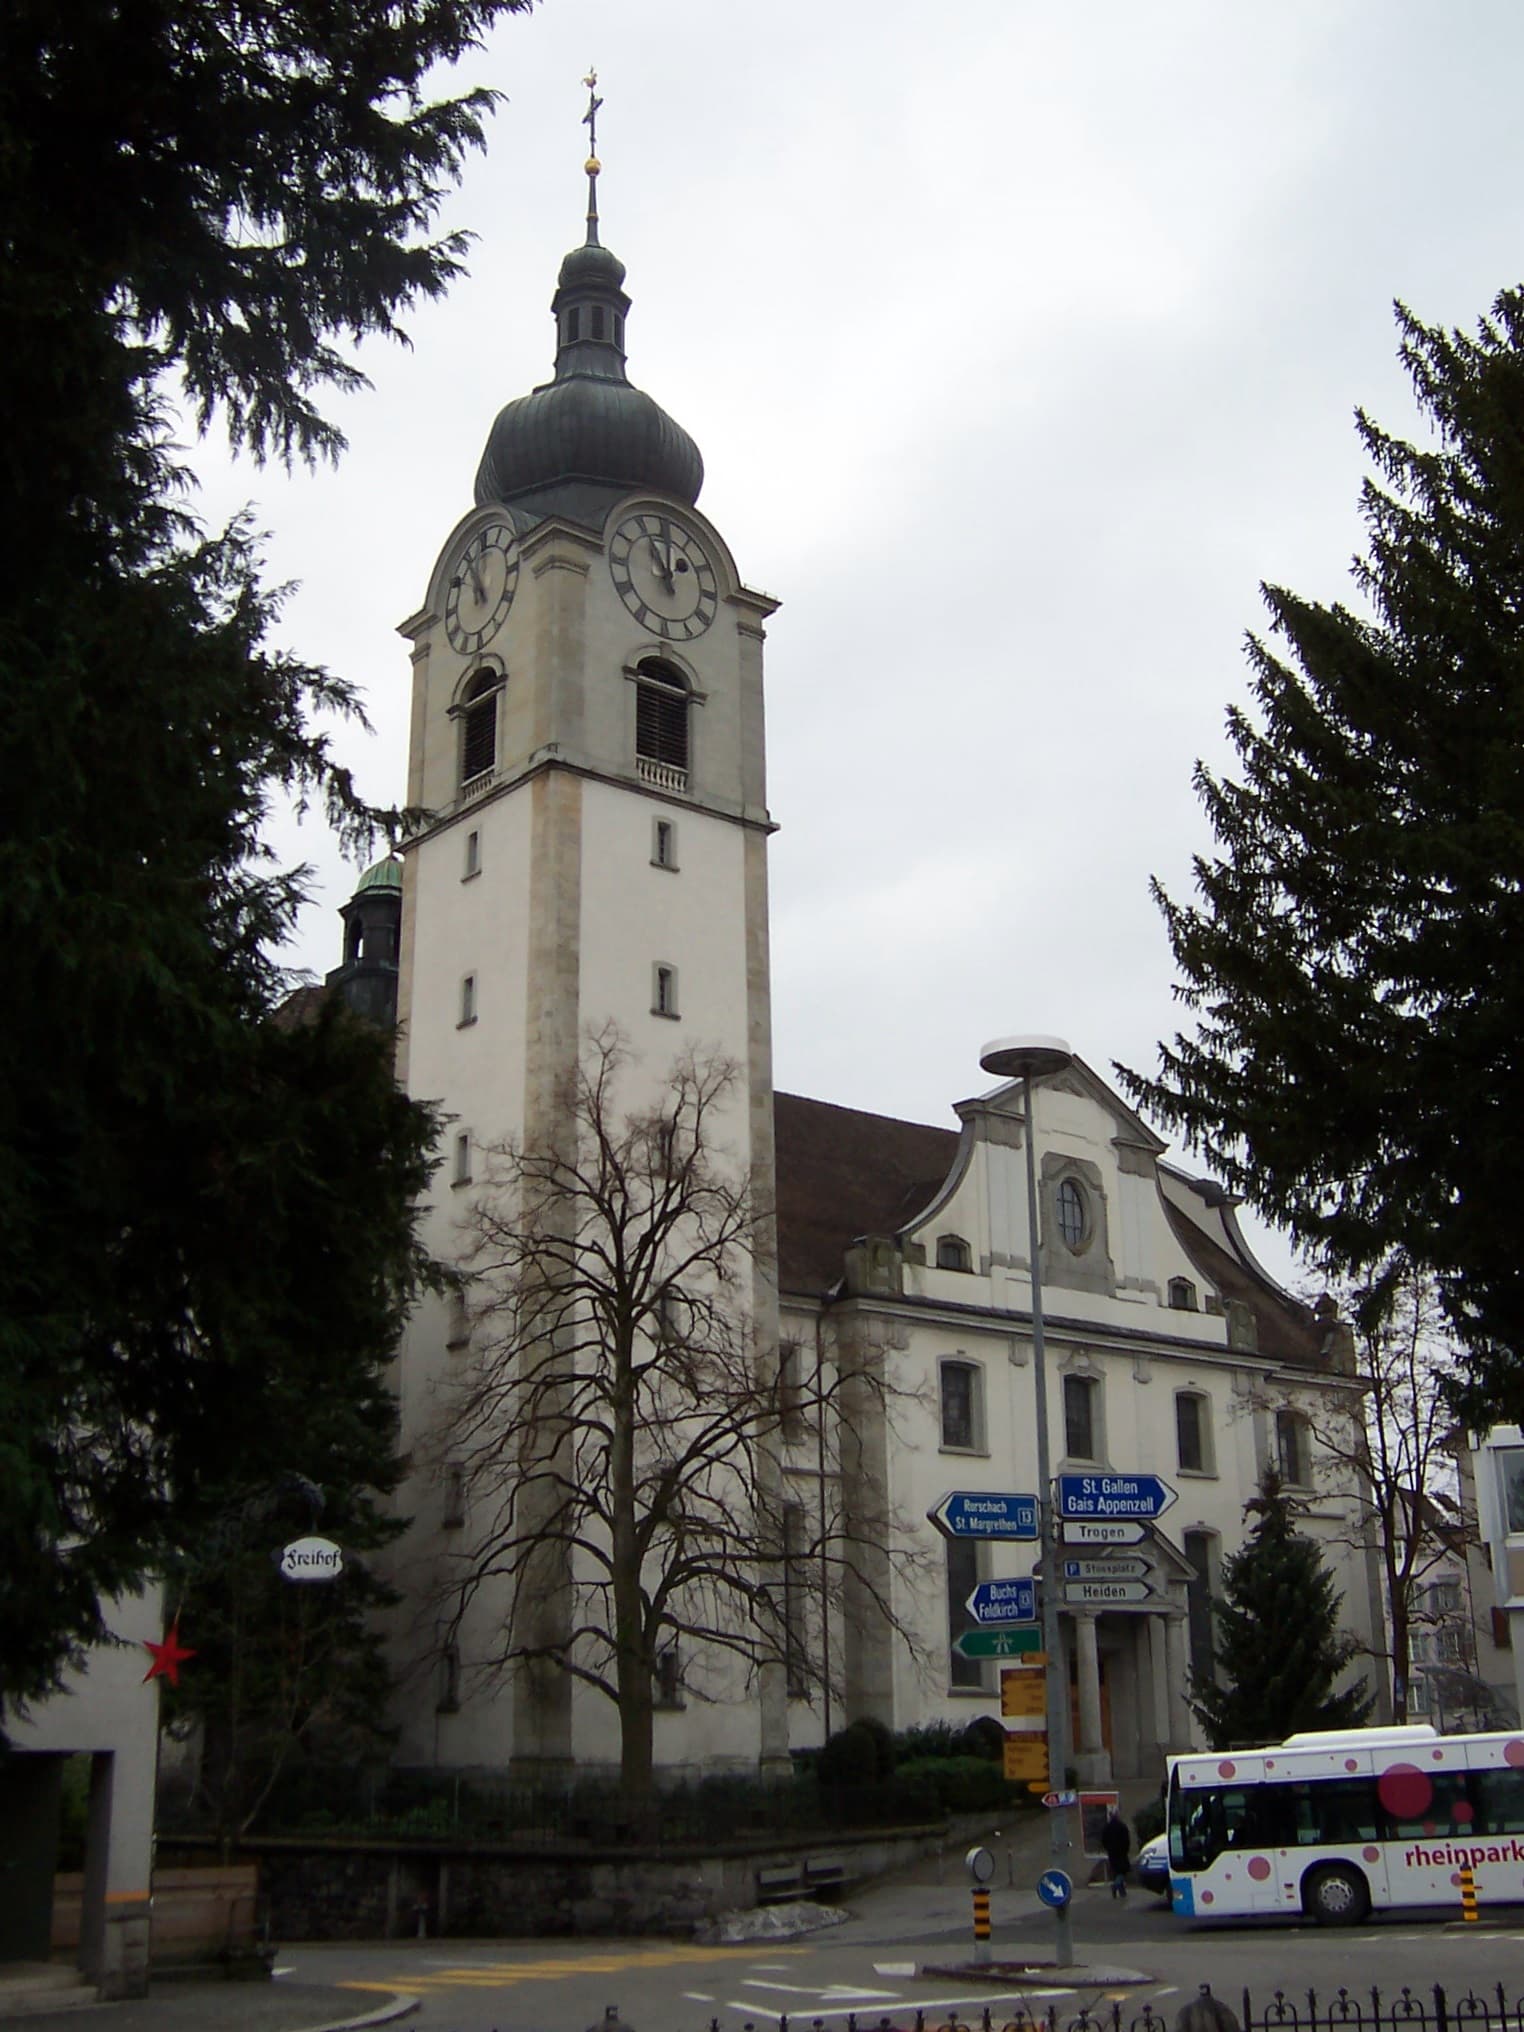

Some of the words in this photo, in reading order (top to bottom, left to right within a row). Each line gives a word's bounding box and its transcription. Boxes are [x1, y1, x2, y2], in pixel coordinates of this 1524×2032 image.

[1082, 1479, 1099, 1494] St.
[1102, 1479, 1138, 1495] Gallen
[1068, 1496, 1094, 1511] Gais
[1097, 1496, 1154, 1515] Appenzell
[955, 1516, 967, 1530] St.
[969, 1517, 1017, 1533] Margrethen
[1022, 1511, 1032, 1523] 13
[1079, 1526, 1125, 1539] Trogen
[287, 1549, 340, 1570] Freihof
[990, 1584, 1017, 1600] Buchs
[1083, 1586, 1126, 1597] Heiden
[979, 1601, 1018, 1618] Feldkirch
